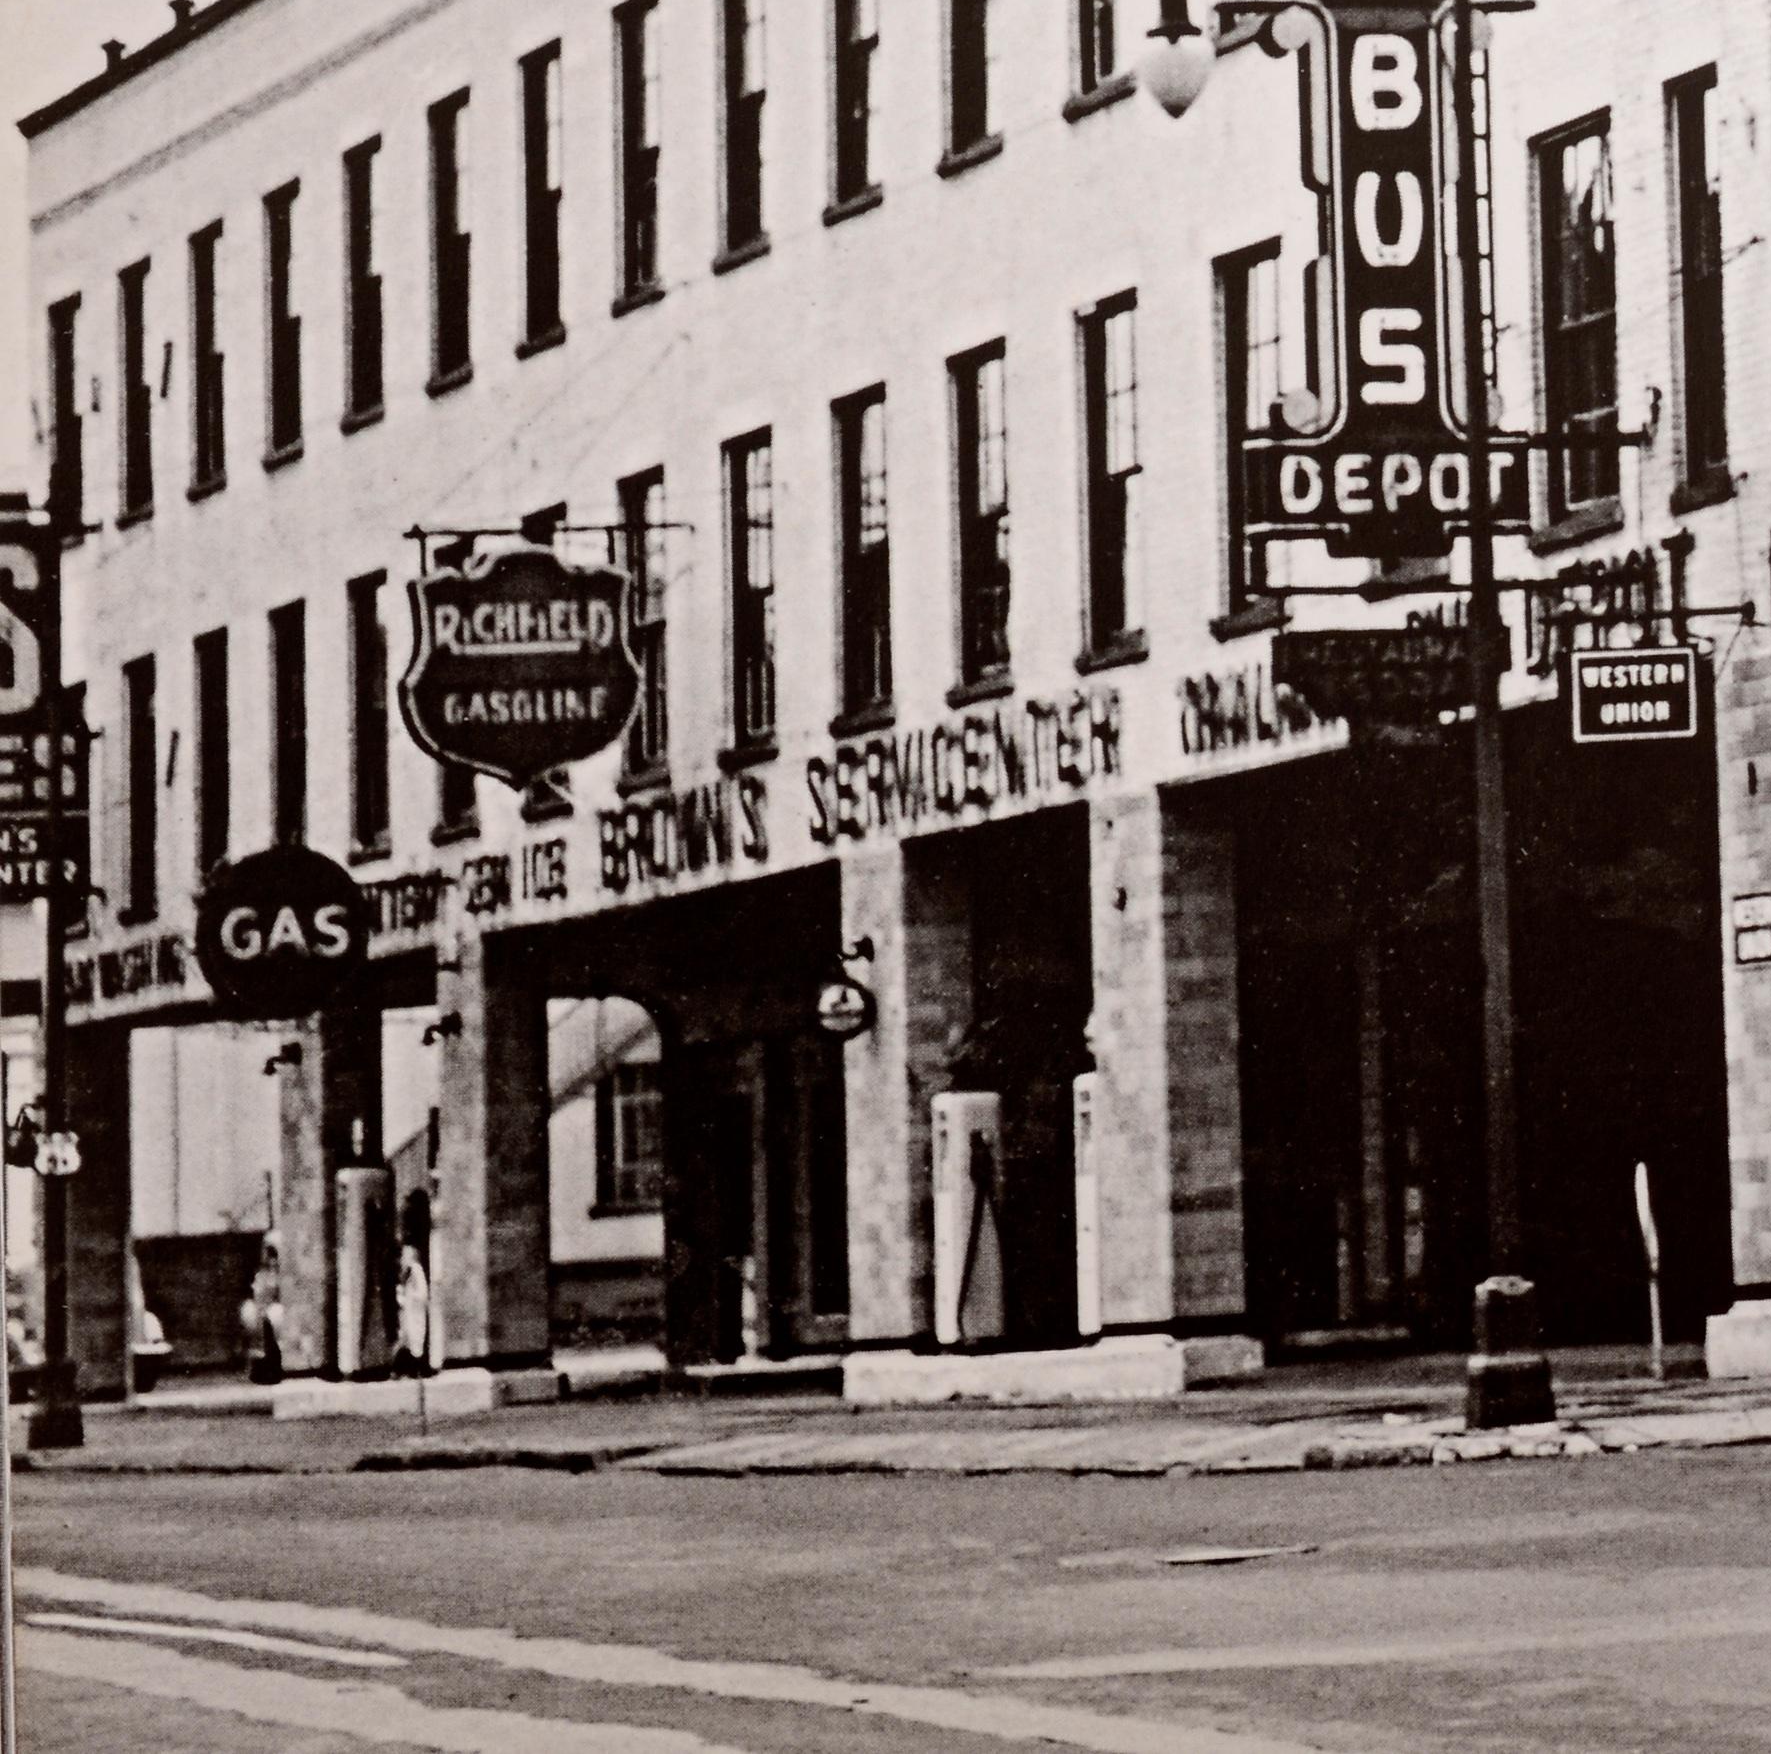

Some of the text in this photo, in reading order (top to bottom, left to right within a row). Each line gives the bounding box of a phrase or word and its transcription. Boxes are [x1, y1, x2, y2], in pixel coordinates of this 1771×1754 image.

[1350, 32, 1426, 404] BUS
[1279, 452, 1515, 514] DEPOT
[434, 599, 614, 655] RICHFIELD
[1581, 664, 1685, 688] WESTERN
[444, 687, 608, 724] GASOLINE
[1600, 700, 1670, 724] UNION
[221, 904, 349, 960] GAS
